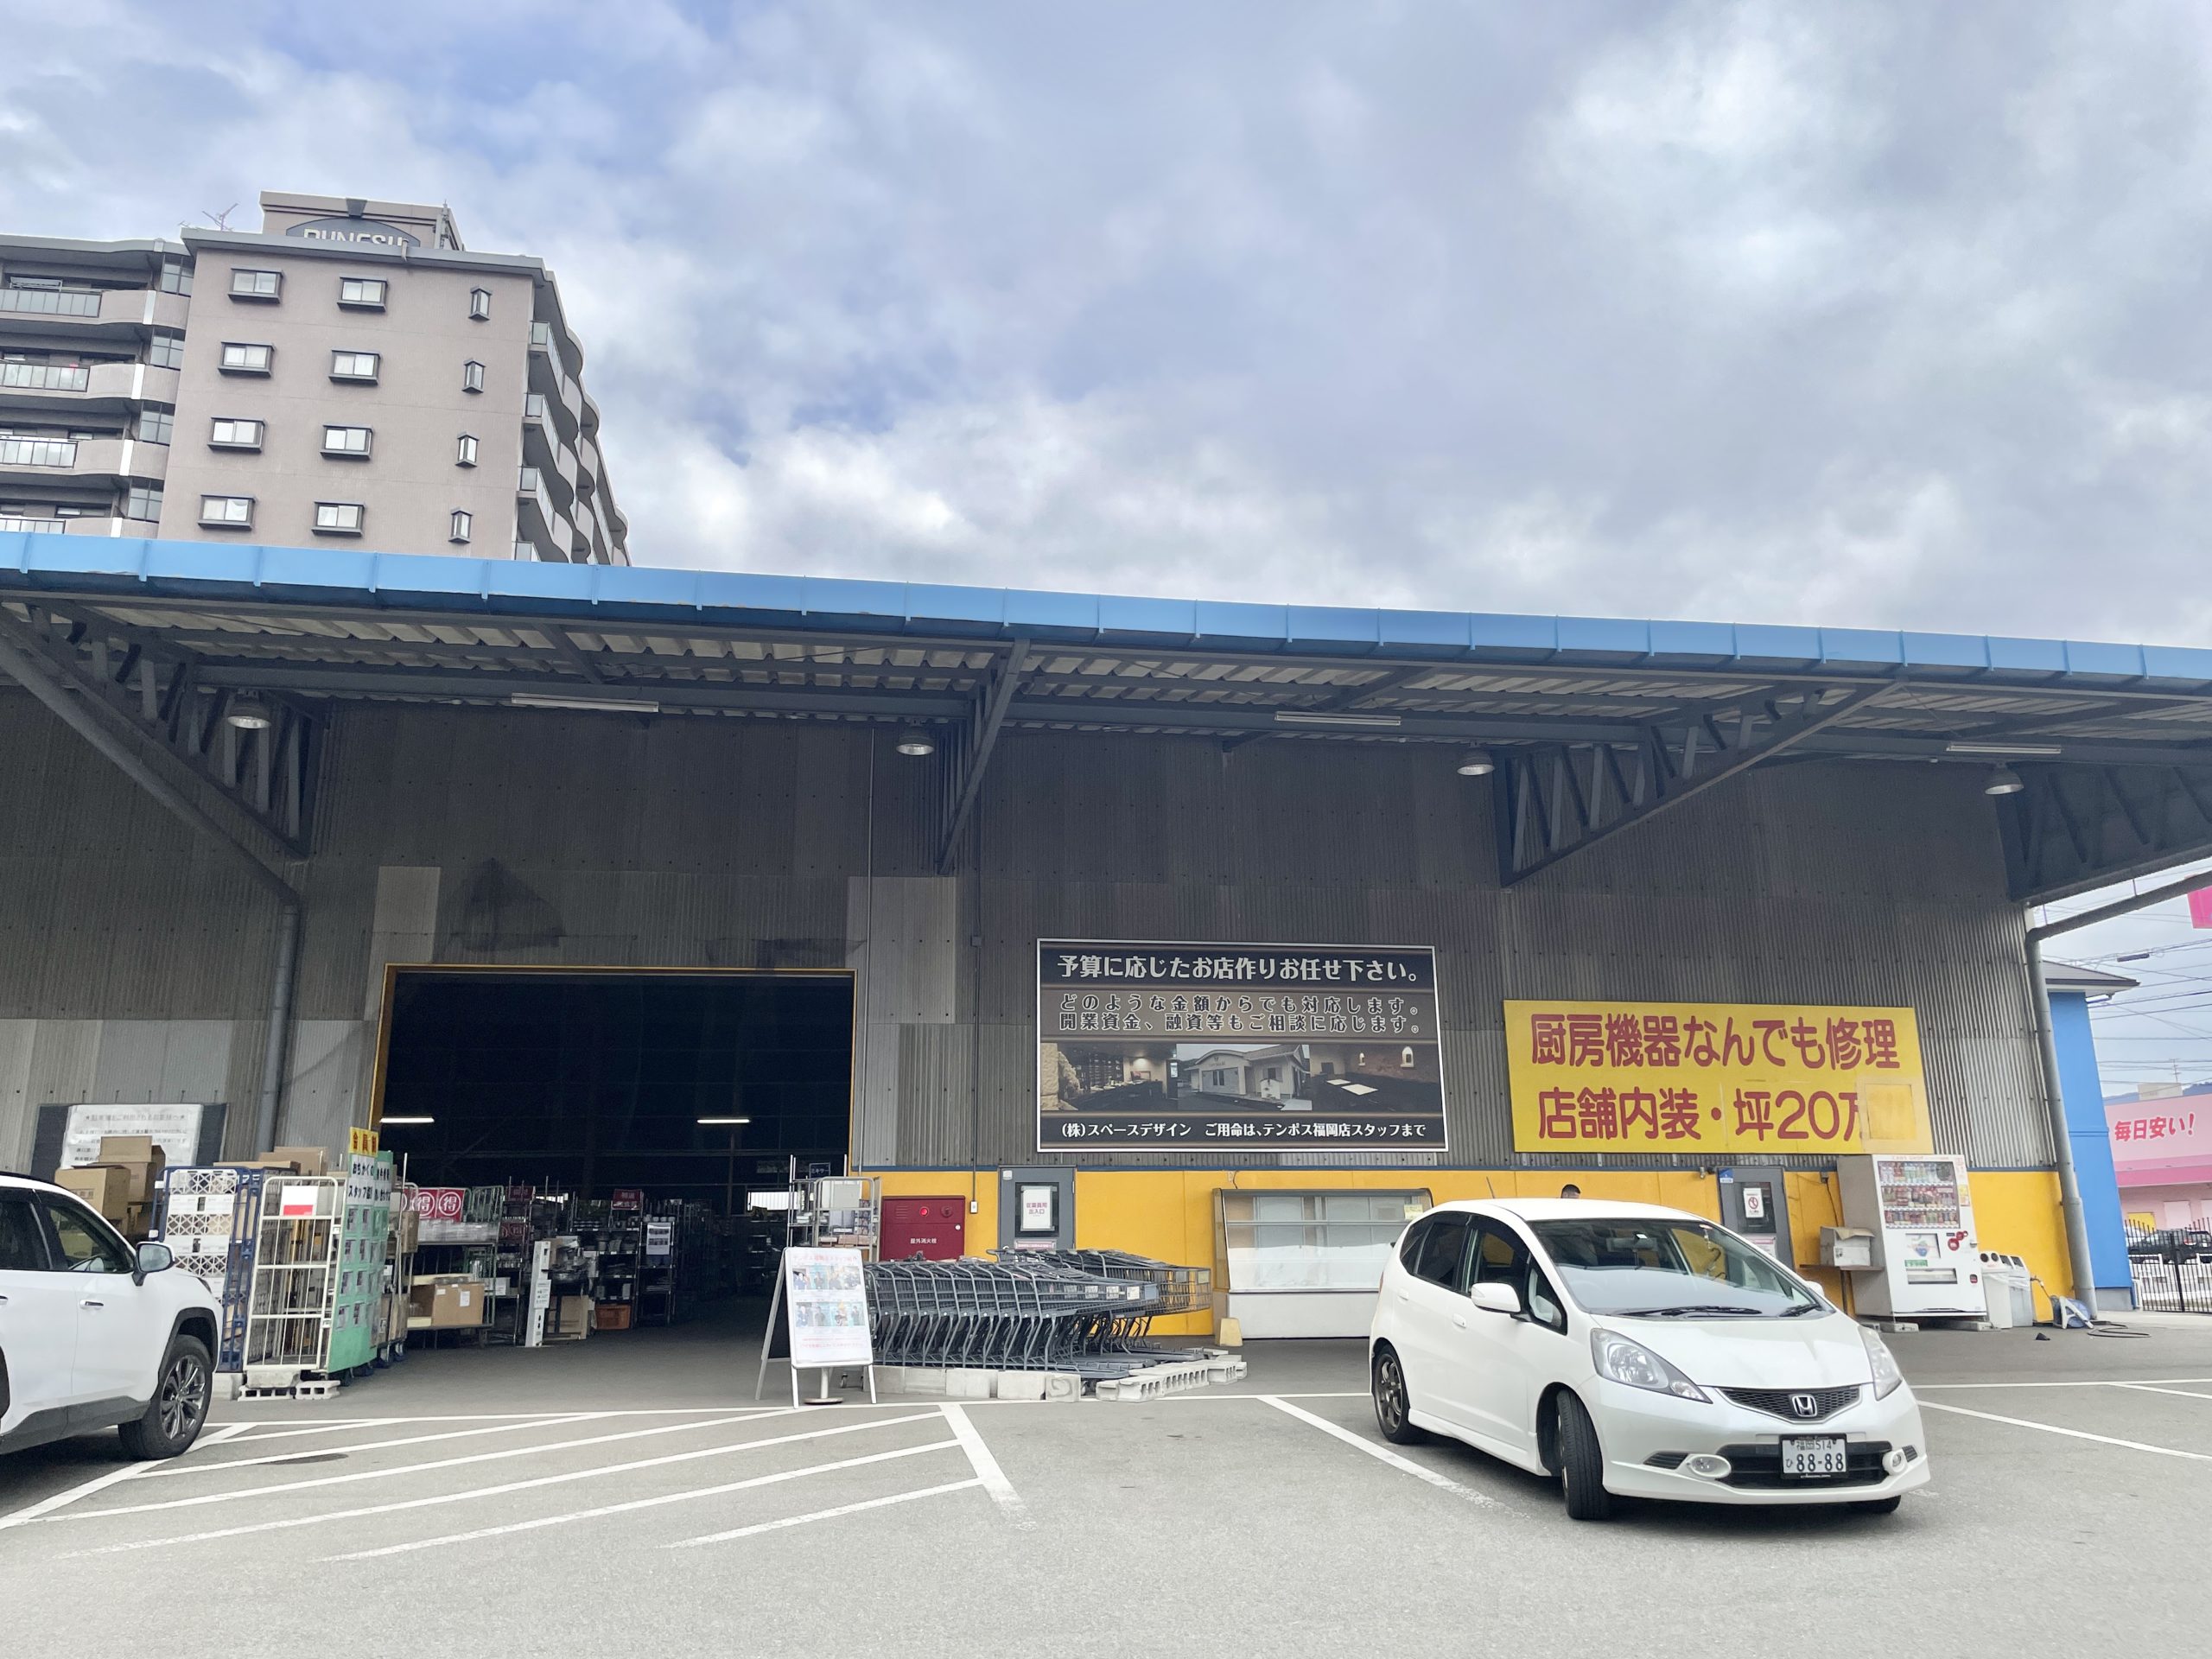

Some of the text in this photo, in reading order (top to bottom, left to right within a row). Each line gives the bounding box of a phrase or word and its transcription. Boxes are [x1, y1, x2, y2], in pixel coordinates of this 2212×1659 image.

[1057, 955, 1417, 982] 予算に応じたお店作りお任せ下さい。
[1060, 994, 1419, 1015] どのような金額からでも対応します。
[1059, 1012, 1420, 1033] 開業資金、融資等もご相談に応じます。
[1530, 1013, 1902, 1071] 厨房機器なんでも修理
[1061, 1122, 1426, 1138] (株)スペースデザイン ご用命は、テンポス福岡店スタッフまで
[1796, 1452, 1844, 1472] 88-88
